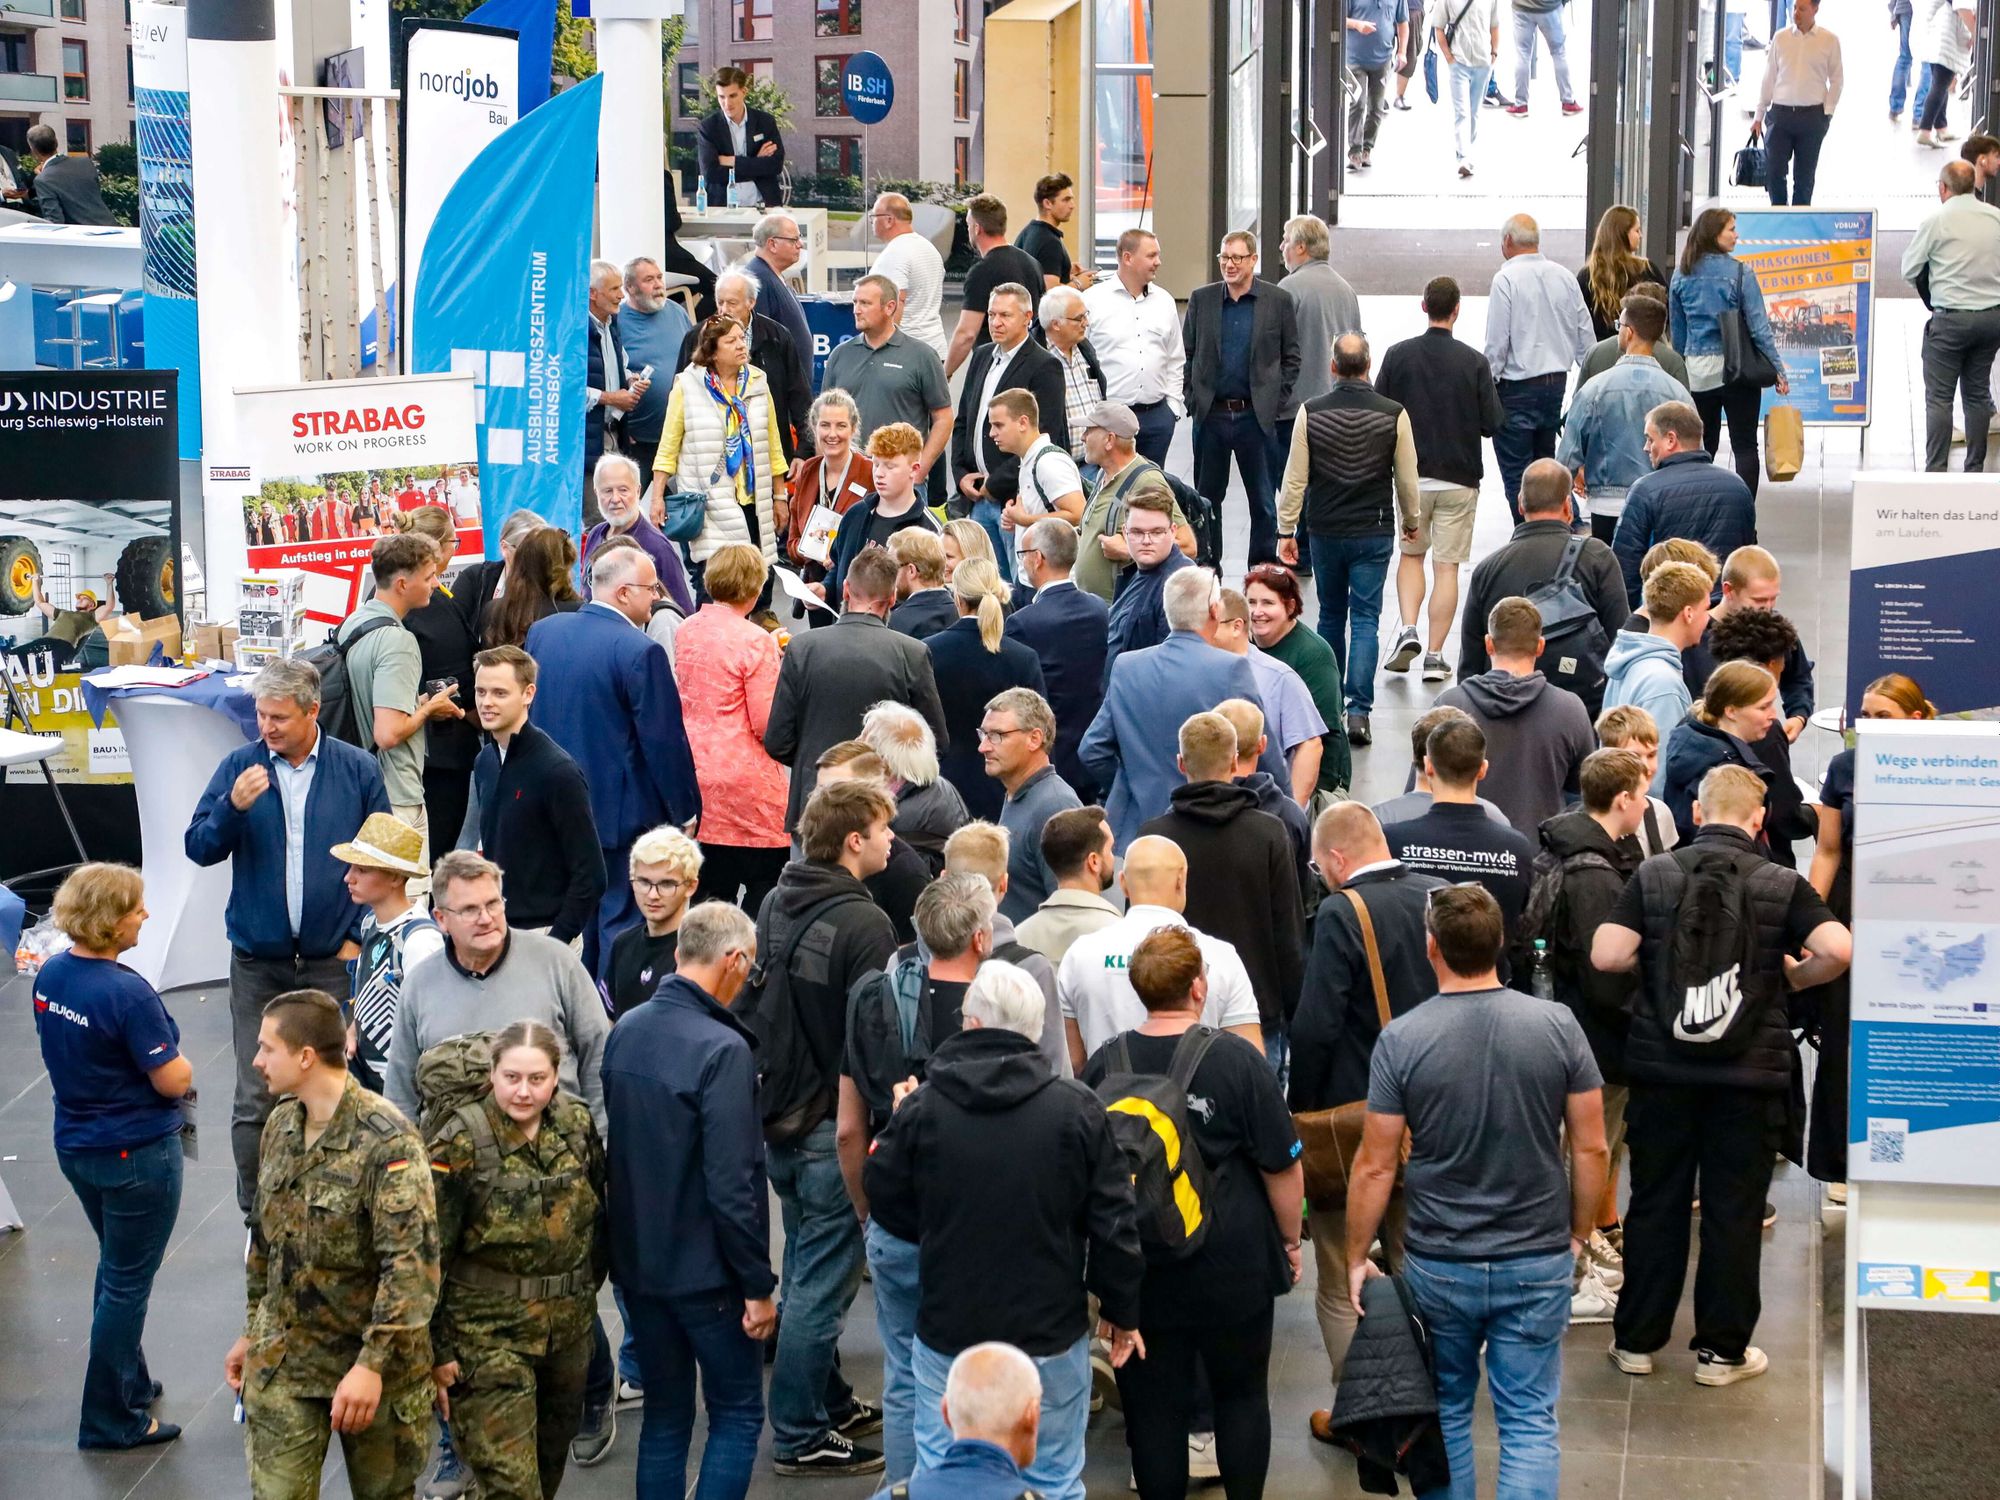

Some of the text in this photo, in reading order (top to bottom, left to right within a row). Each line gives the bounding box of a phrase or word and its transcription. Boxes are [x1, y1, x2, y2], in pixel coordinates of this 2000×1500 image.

[420, 68, 498, 101] nordjob
[848, 74, 886, 95] IB.SH
[858, 95, 886, 106] Förderbank
[489, 110, 507, 125] Bau
[1834, 221, 1860, 229] VDBUM
[527, 251, 548, 465] AUSBILDUNGSZENTRUM
[545, 353, 561, 465] AHRENSBÖK
[27, 414, 164, 430] Schleswig-Holstein
[292, 404, 425, 438] STRABAG
[293, 434, 427, 454] WORK ON PROGRESS
[210, 469, 250, 478] STRABAG
[1877, 509, 1999, 521] Wir halten das Land
[1876, 528, 1943, 538] am Laufen.
[281, 548, 370, 564] Aufstieg in der
[1875, 753, 1998, 769] Wege verbinden
[1875, 774, 1952, 785] Infrastruktur
[1955, 776, 1976, 785] mit
[1402, 844, 1517, 865] strassen-mv.de
